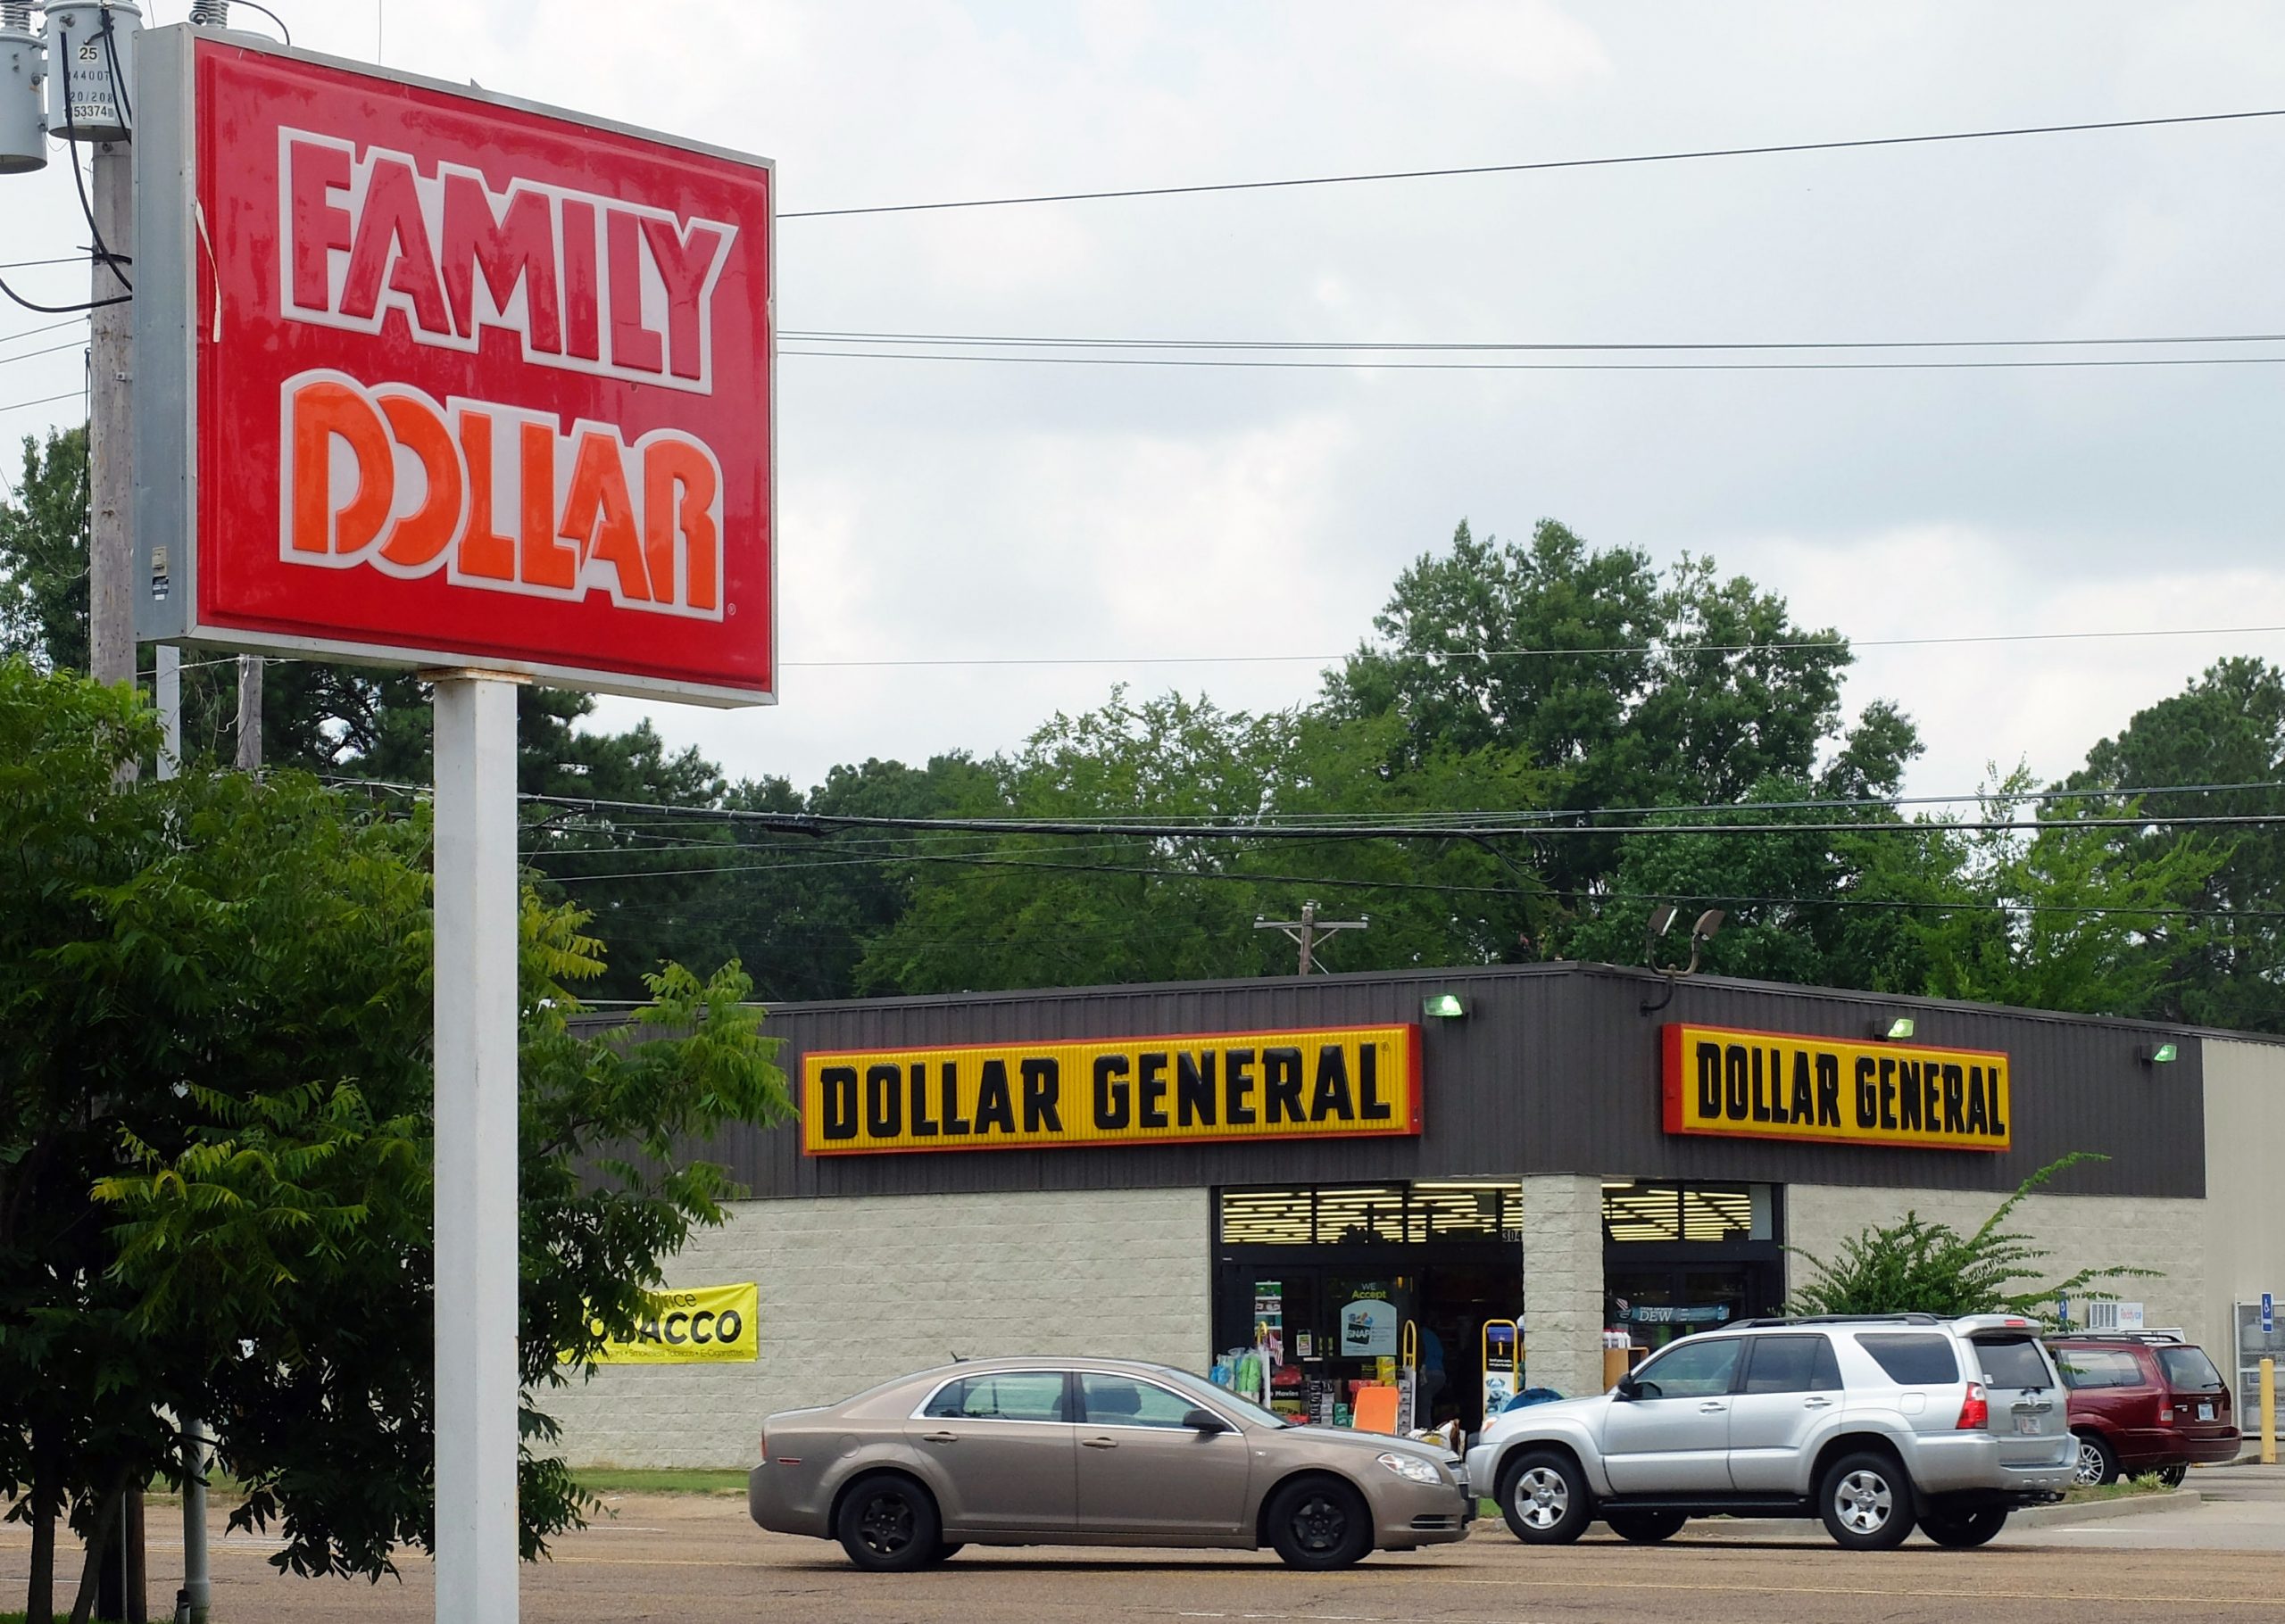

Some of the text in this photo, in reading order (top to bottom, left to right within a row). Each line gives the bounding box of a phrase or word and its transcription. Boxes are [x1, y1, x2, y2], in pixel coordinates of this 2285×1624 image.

[79, 47, 97, 60] 25
[71, 91, 113, 104] 20/208
[71, 105, 107, 118] 53374
[278, 125, 739, 395] FAMILY
[279, 368, 724, 623] DOLLAR
[820, 1041, 1392, 1140] DOLLAR GENERAL
[1696, 1040, 2006, 1136] DOLLAR GENERAL
[1361, 1282, 1376, 1290] WE
[1351, 1290, 1387, 1299] Accept
[1639, 1310, 1672, 1322] DEW
